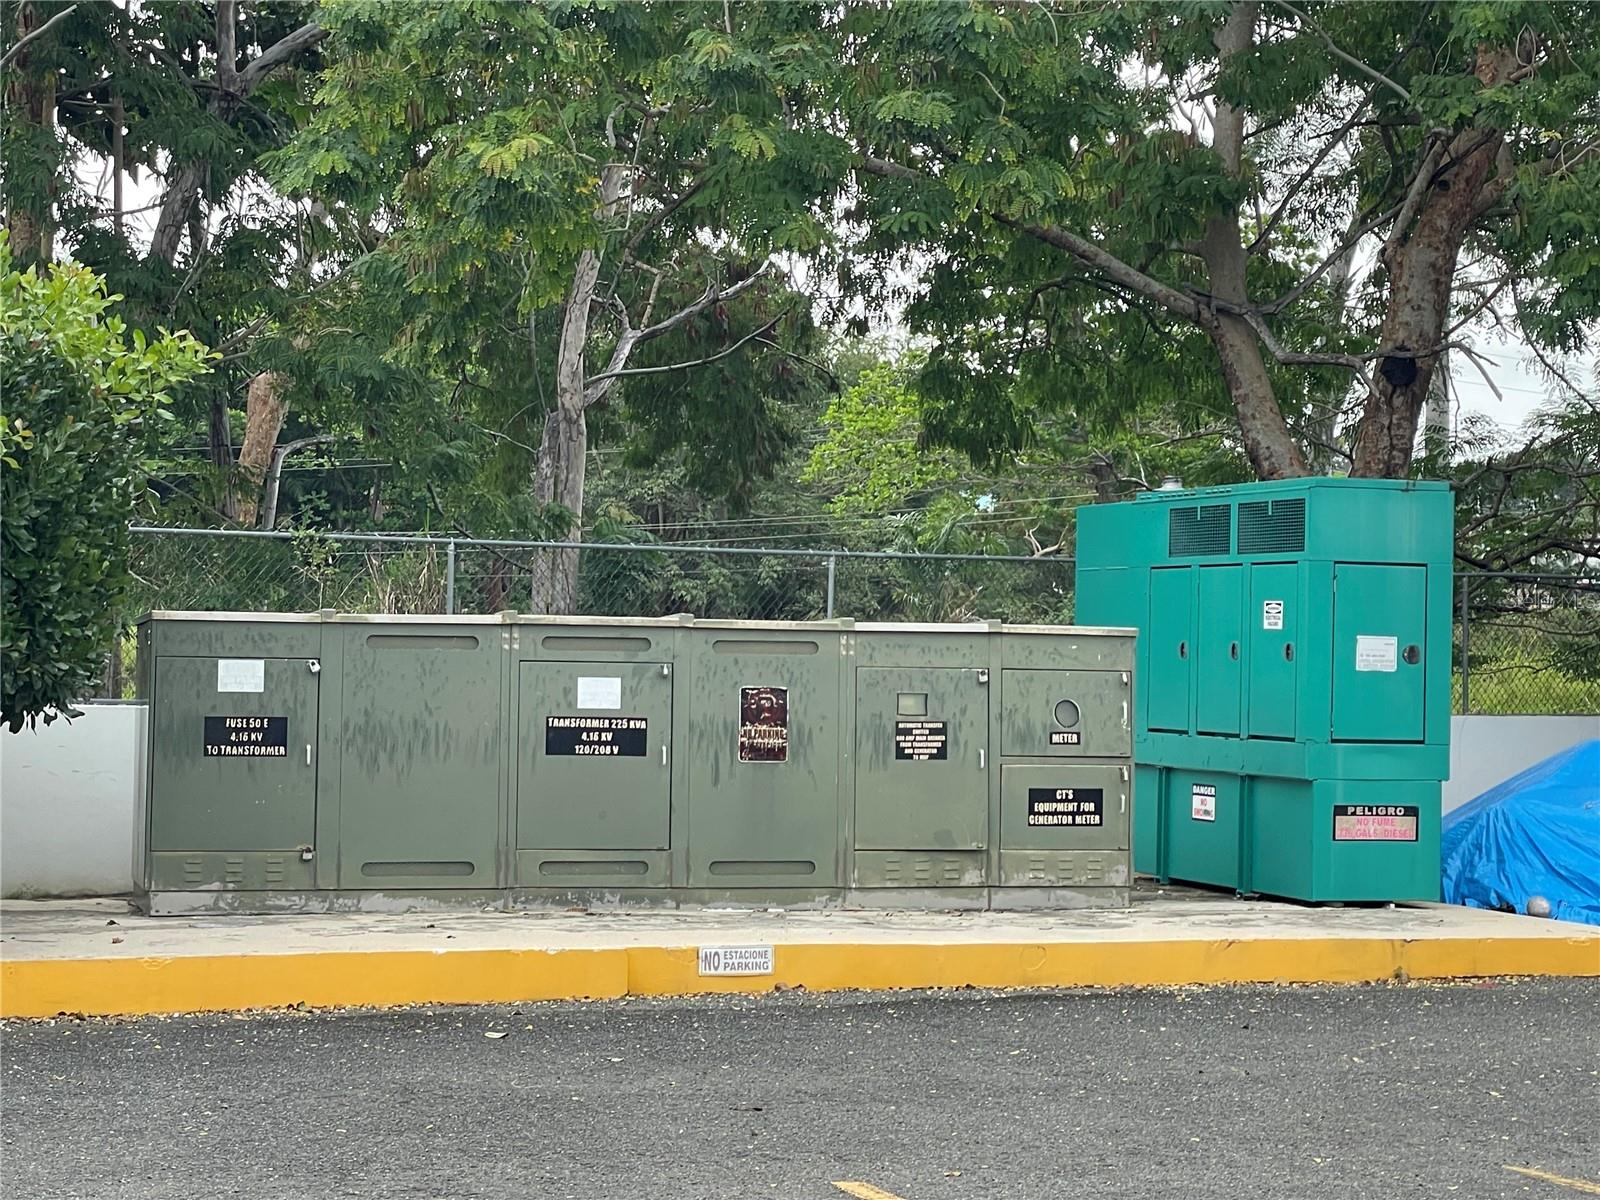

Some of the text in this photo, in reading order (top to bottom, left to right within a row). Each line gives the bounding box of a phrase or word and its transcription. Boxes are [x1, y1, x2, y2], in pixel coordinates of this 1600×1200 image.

[226, 718, 269, 728] FUSE 50 E
[548, 718, 646, 729] TRANSFORMER 225 KVA
[230, 732, 263, 741] 4.16 KV
[581, 732, 613, 741] 4.16 KV
[754, 728, 785, 740] PARKING
[1051, 733, 1078, 744] METER
[207, 745, 285, 756] TO TRANSFORMER
[575, 745, 619, 755] 120/208 V
[1056, 789, 1074, 800] CT'S
[1192, 785, 1216, 796] DANGER
[1034, 802, 1095, 813] EQUIPMENT FOR
[1200, 798, 1208, 806] NO
[1193, 808, 1214, 818] SMOG
[1347, 806, 1405, 816] PELIGRO
[1029, 814, 1100, 825] GENERATOR METER
[1356, 817, 1396, 827] NO FUME
[704, 950, 769, 971] NO ESTACIONE
[723, 960, 769, 971] PARKING
